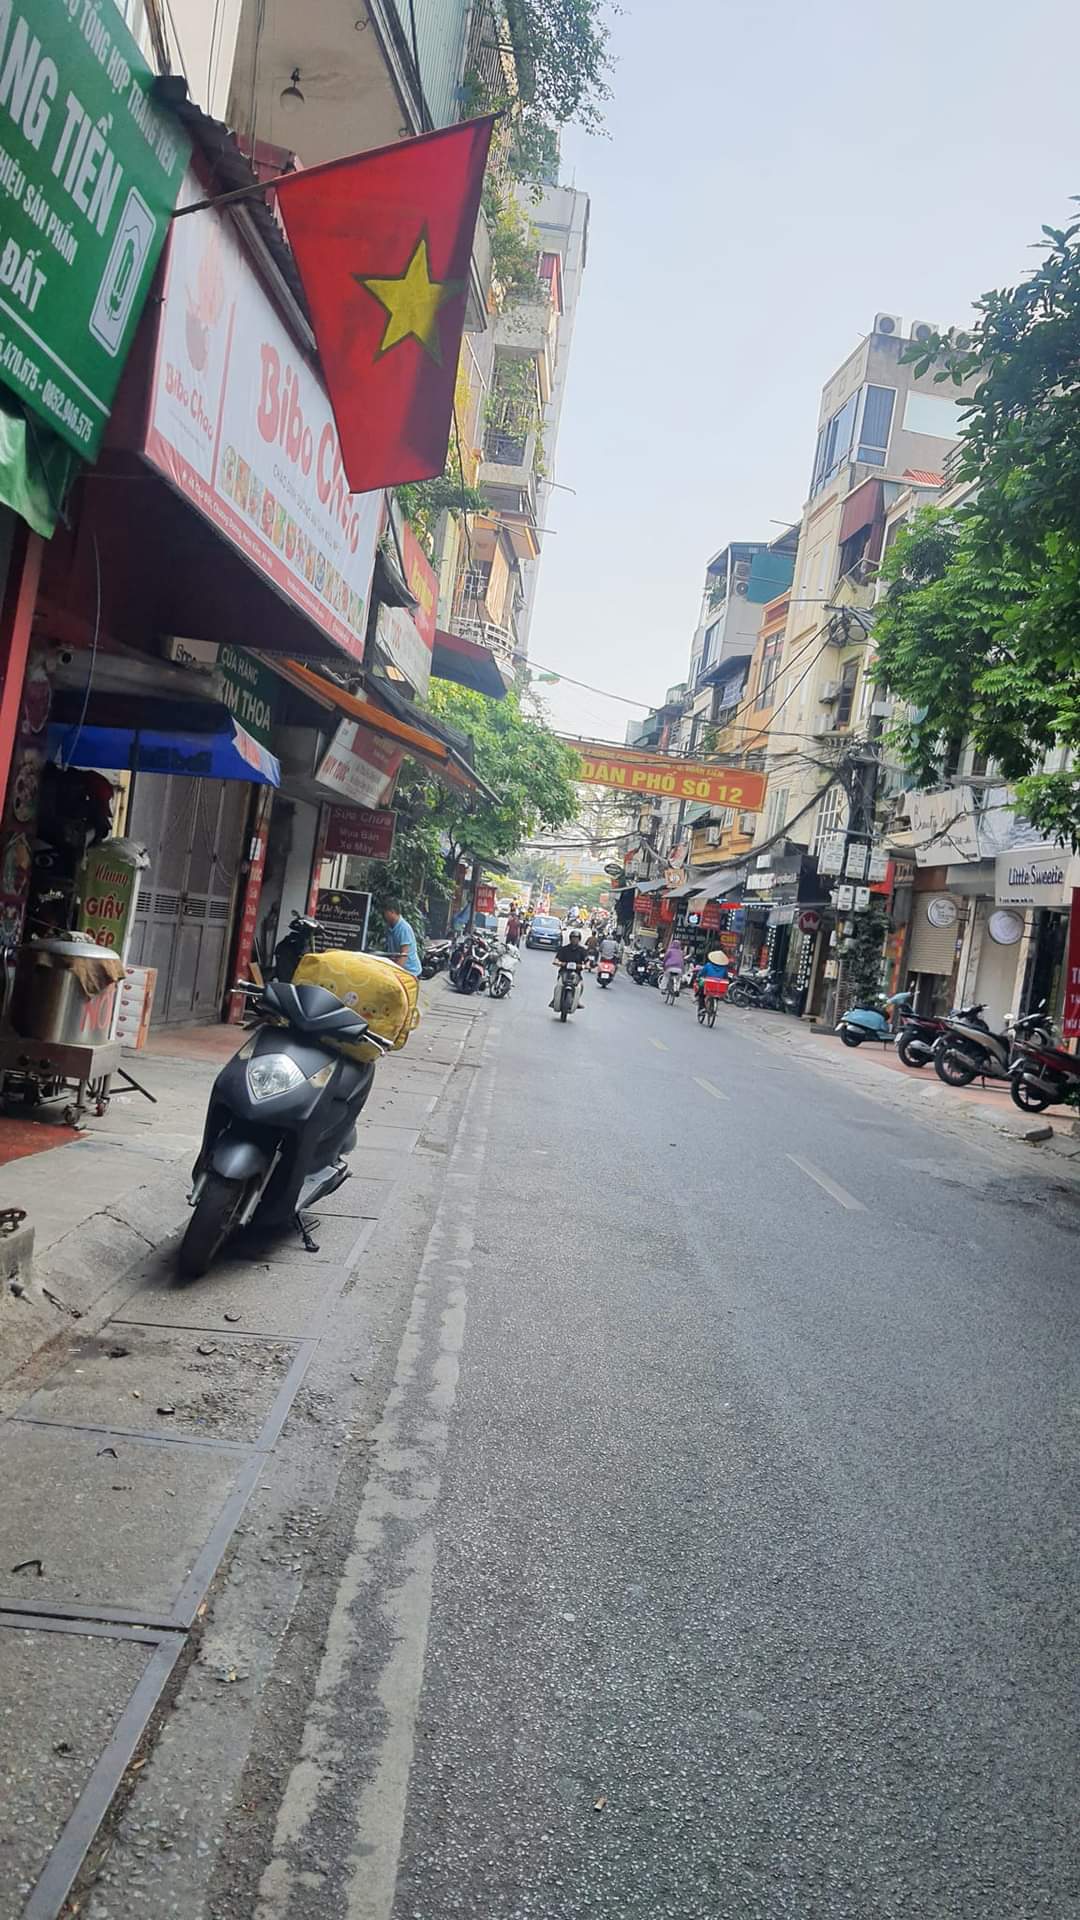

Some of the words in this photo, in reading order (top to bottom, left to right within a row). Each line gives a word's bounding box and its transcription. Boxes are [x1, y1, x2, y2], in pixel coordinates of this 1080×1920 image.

[106, 45, 131, 94] HỢP
[23, 183, 50, 230] SẢN
[44, 210, 79, 267] PHẨM
[0, 236, 48, 313] ĐẤT
[165, 361, 190, 407] Bibo
[255, 341, 314, 477] Bibo
[241, 689, 271, 731] THOA
[580, 760, 626, 785] DÂN
[631, 770, 676, 793] PHỐ
[682, 777, 713, 798] SỐ
[718, 785, 743, 803] 12
[1008, 866, 1029, 886] Little
[1031, 865, 1063, 885] Sweetie
